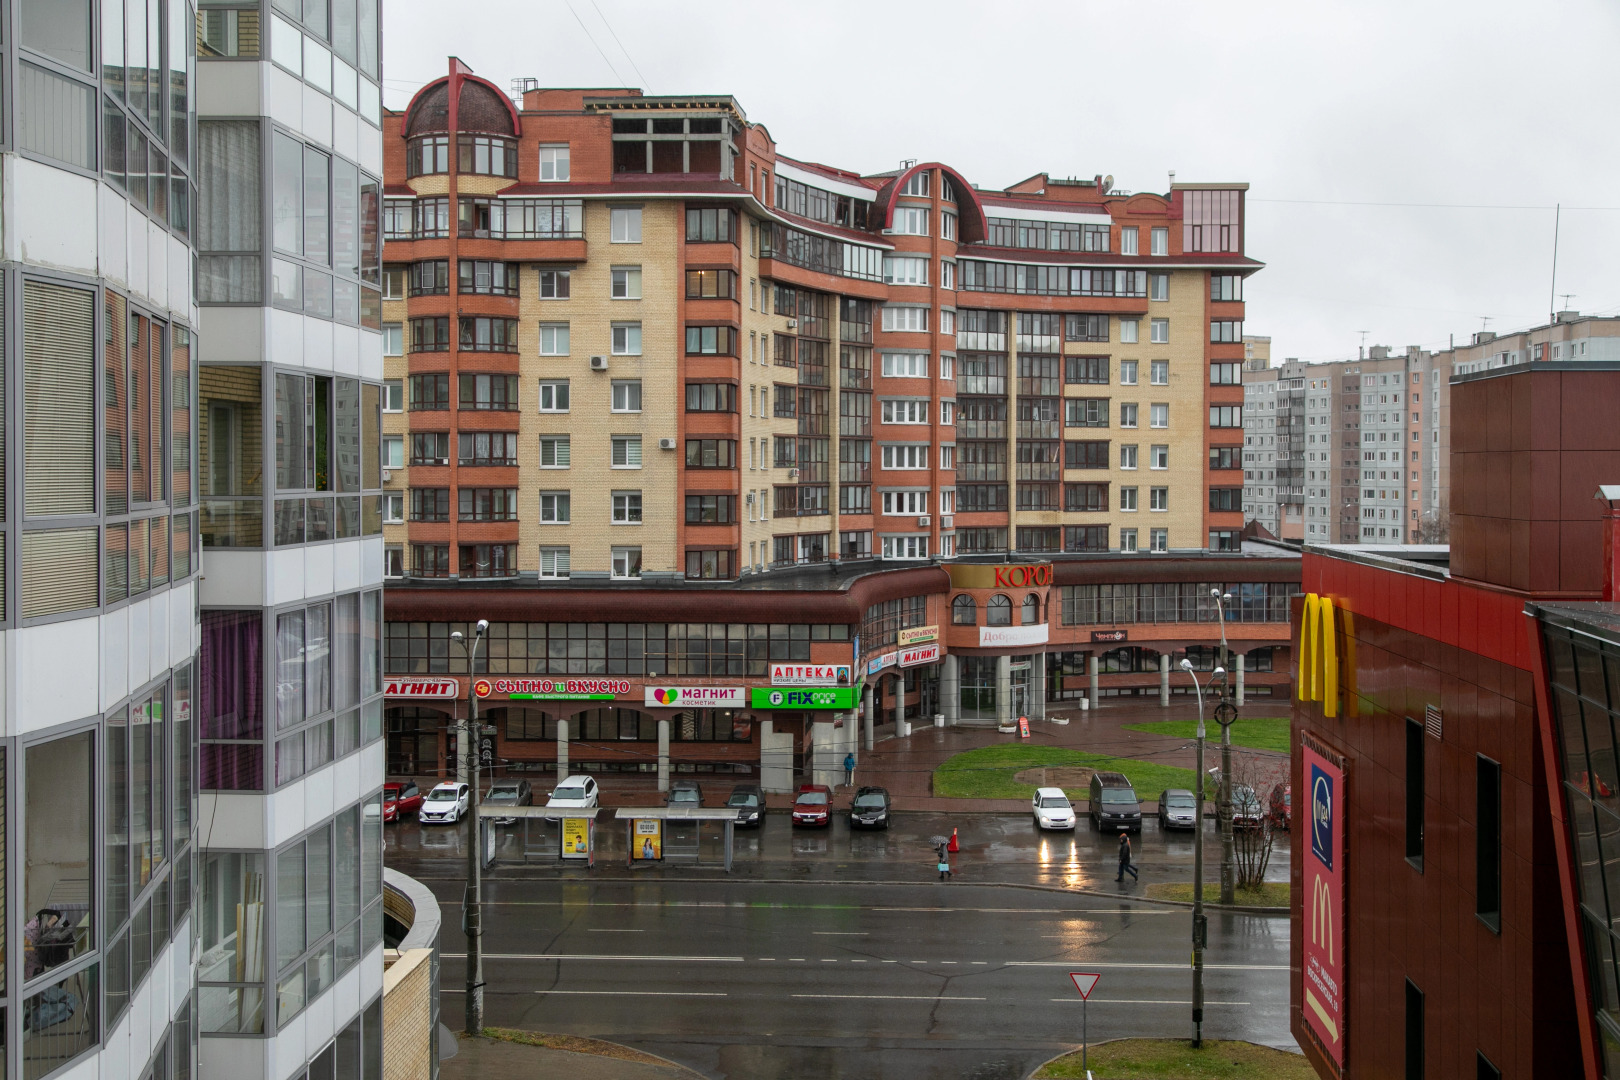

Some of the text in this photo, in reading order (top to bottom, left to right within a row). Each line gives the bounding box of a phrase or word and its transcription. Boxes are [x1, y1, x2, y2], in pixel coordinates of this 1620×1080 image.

[904, 648, 937, 663] МАГНИТ
[774, 667, 835, 677] АПТЕКА
[384, 683, 451, 694] АГНИТ
[495, 680, 630, 693] СЫТНО и ВКУСНО
